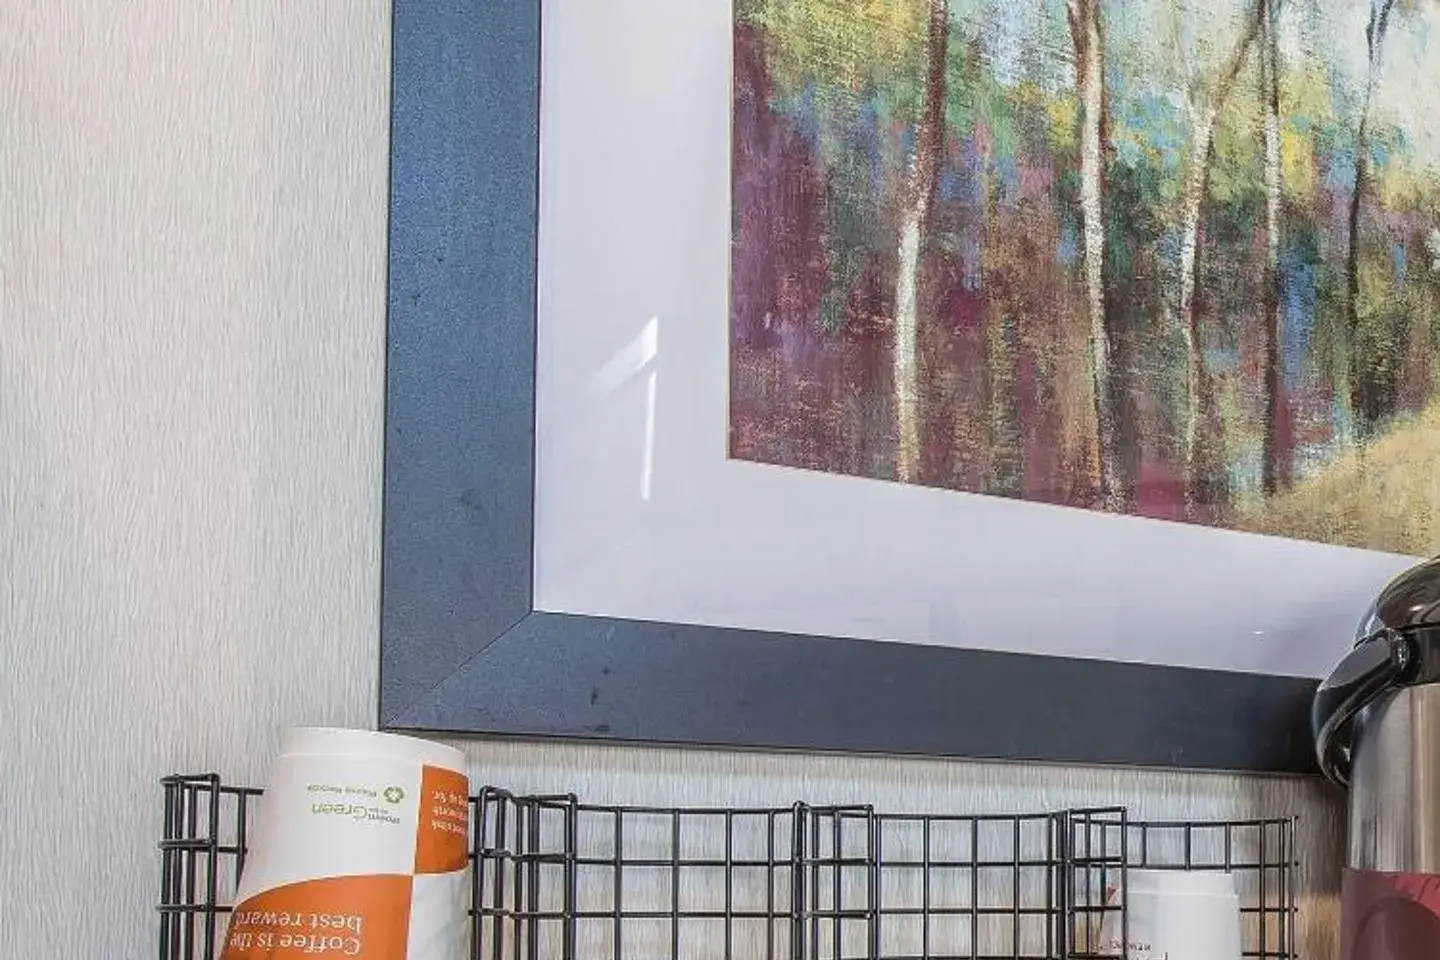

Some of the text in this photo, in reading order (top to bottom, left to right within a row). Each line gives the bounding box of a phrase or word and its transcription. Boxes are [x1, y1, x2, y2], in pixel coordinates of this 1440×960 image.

[310, 914, 362, 933] best
[258, 932, 273, 950] is
[280, 933, 361, 955] Coffee
